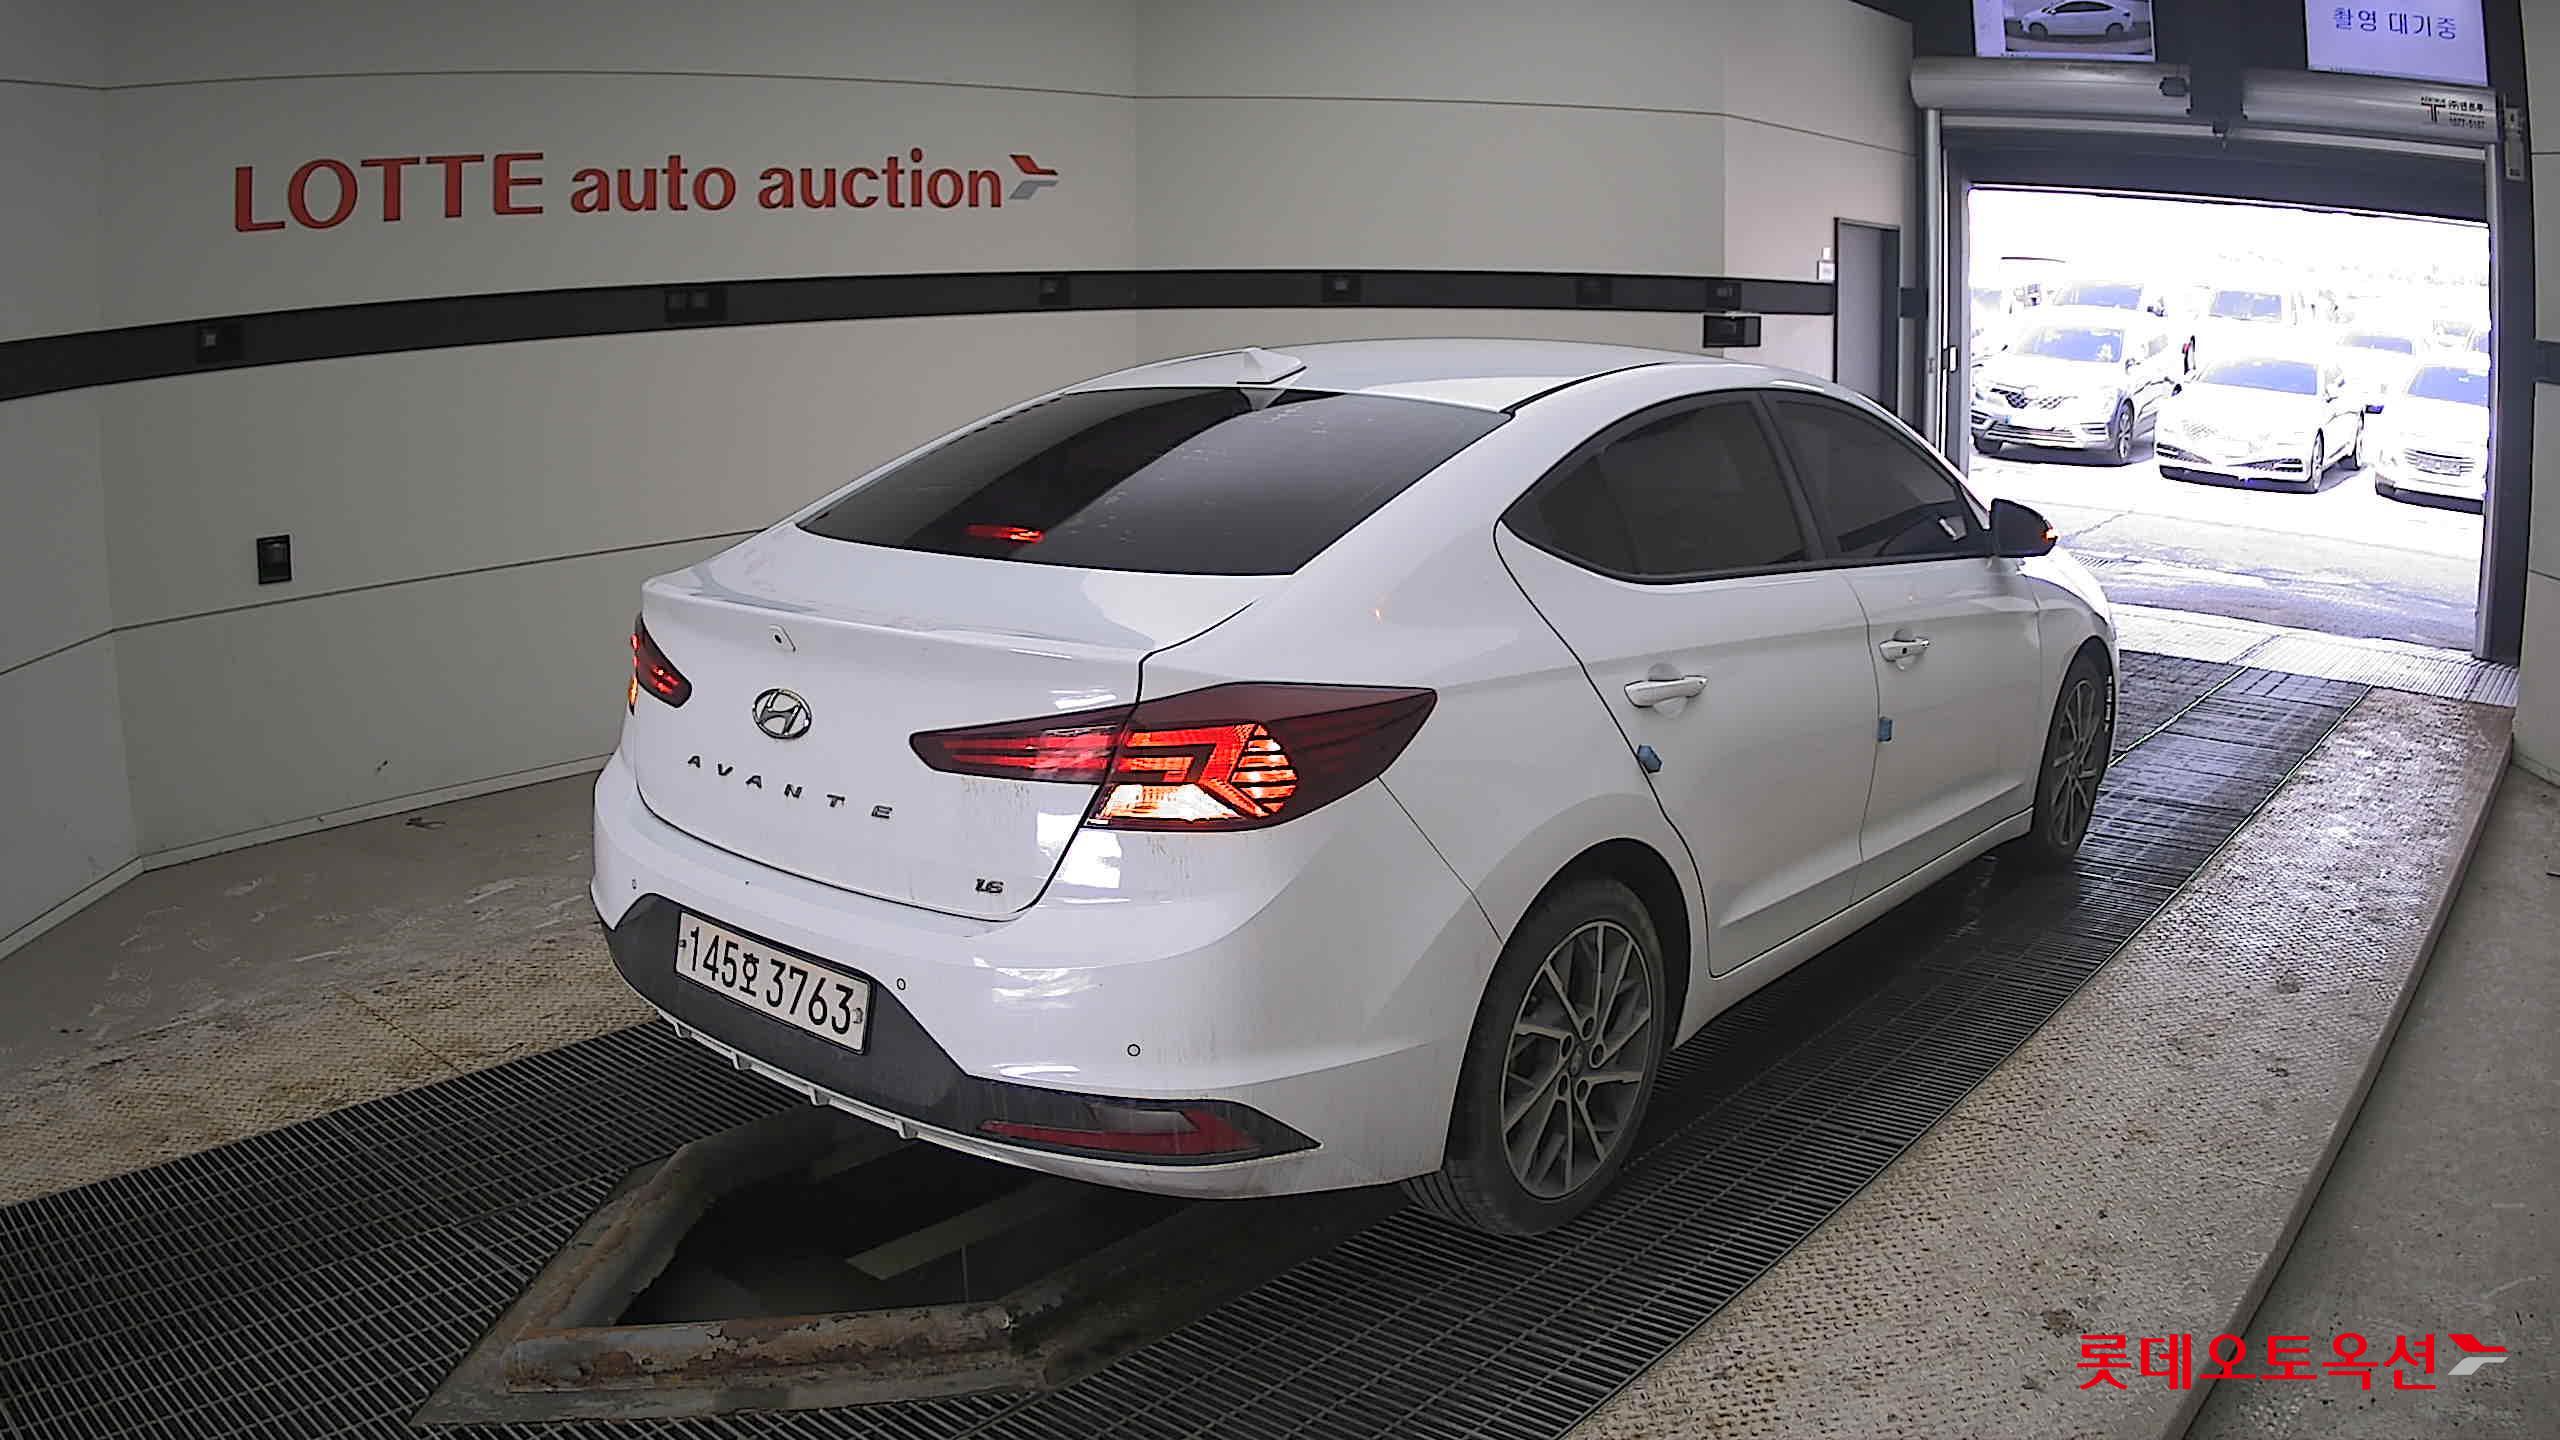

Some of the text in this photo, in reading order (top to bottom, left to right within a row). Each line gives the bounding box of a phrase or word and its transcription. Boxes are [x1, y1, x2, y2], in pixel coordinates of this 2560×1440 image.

[2334, 7, 2456, 40] 촬영 대기중
[234, 147, 1003, 232] LOTTE auto auction
[687, 755, 893, 819] AVANTE
[766, 958, 854, 1035] 3763
